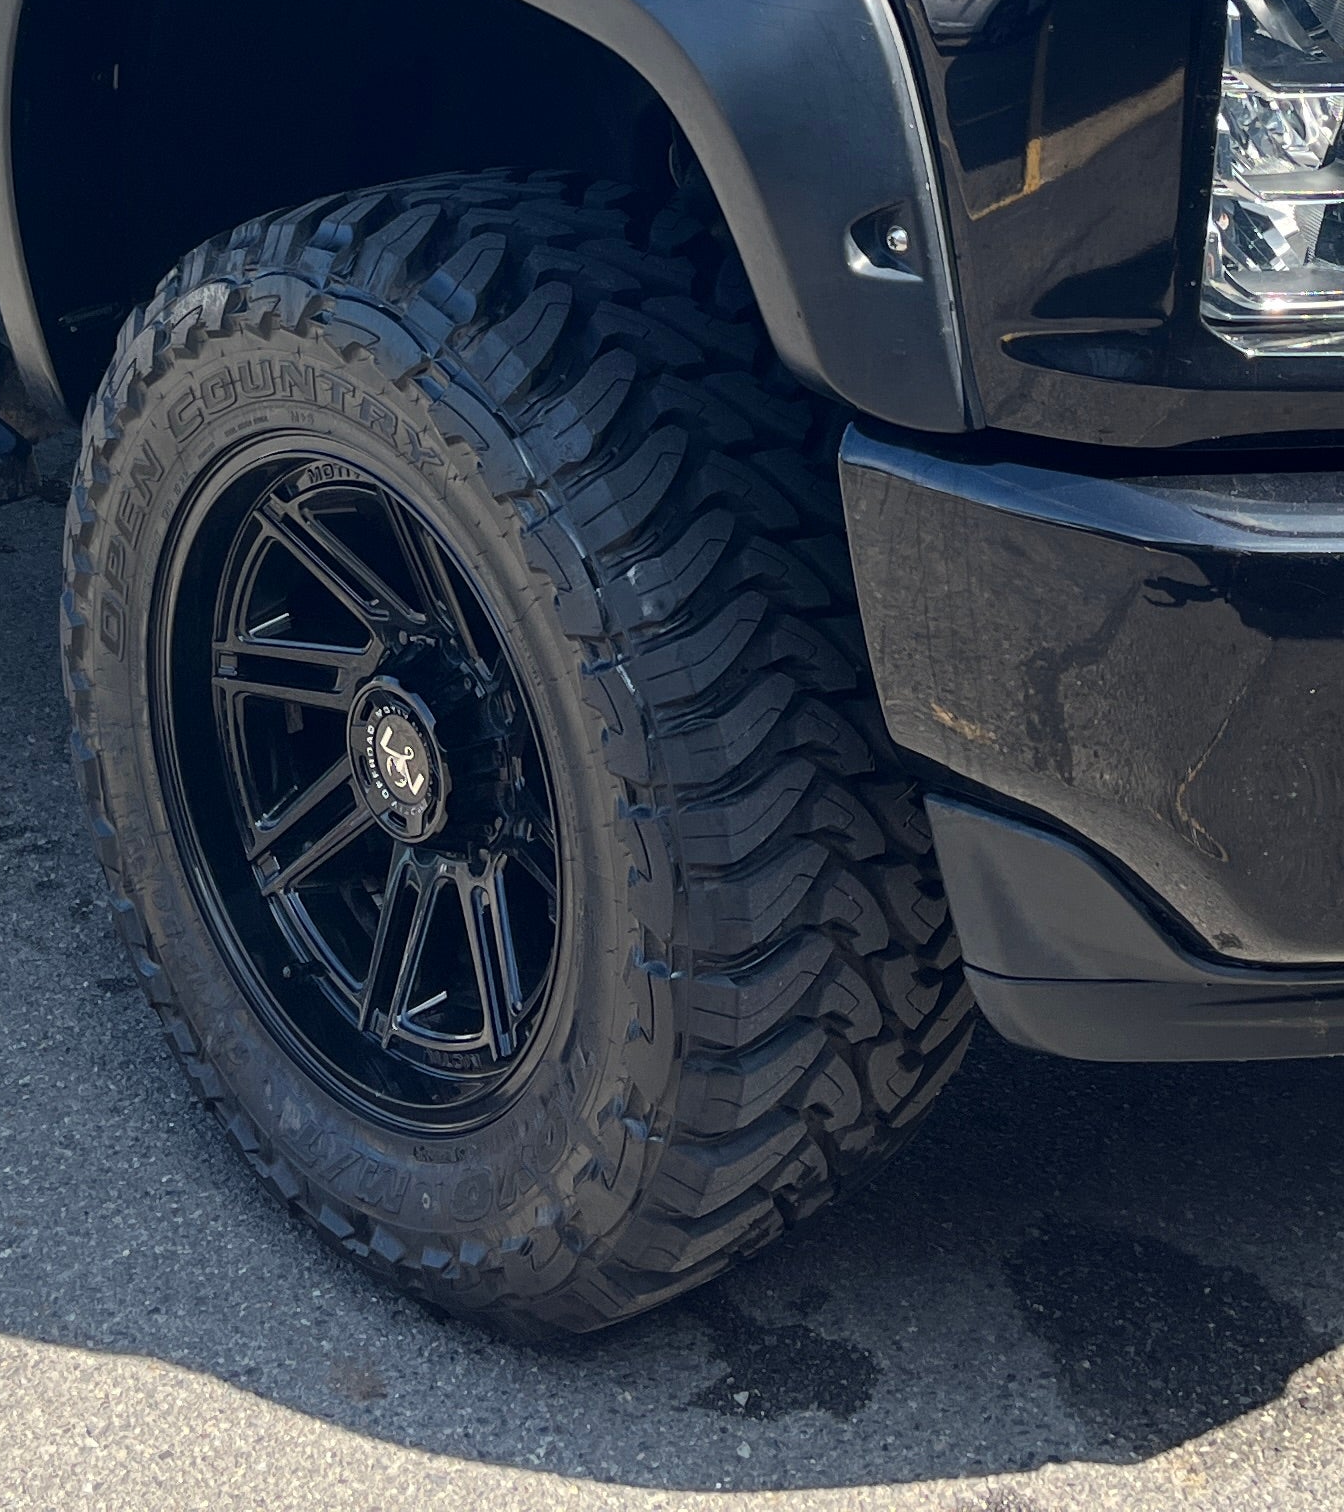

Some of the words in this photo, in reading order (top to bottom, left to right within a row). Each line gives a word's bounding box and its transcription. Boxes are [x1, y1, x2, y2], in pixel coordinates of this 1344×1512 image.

[98, 437, 166, 662] OPEN
[167, 358, 445, 470] COUNTRY
[366, 725, 390, 800] OFFROAD
